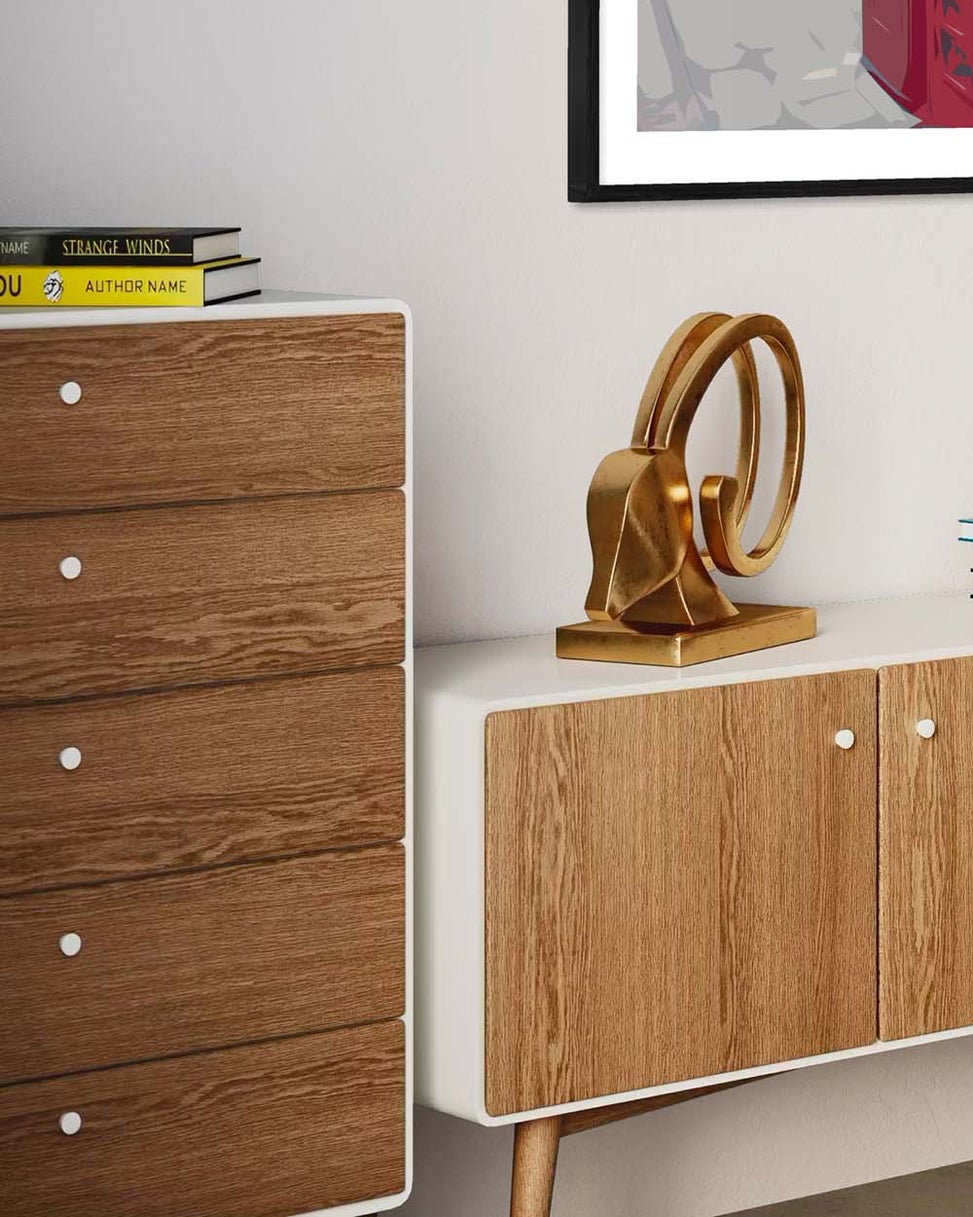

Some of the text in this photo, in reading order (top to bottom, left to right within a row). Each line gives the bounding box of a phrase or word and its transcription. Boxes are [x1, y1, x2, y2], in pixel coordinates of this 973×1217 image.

[62, 239, 118, 255] STRANGE
[126, 239, 171, 255] WINDS
[85, 280, 143, 293] AUTHOR
[147, 280, 187, 293] NAME
